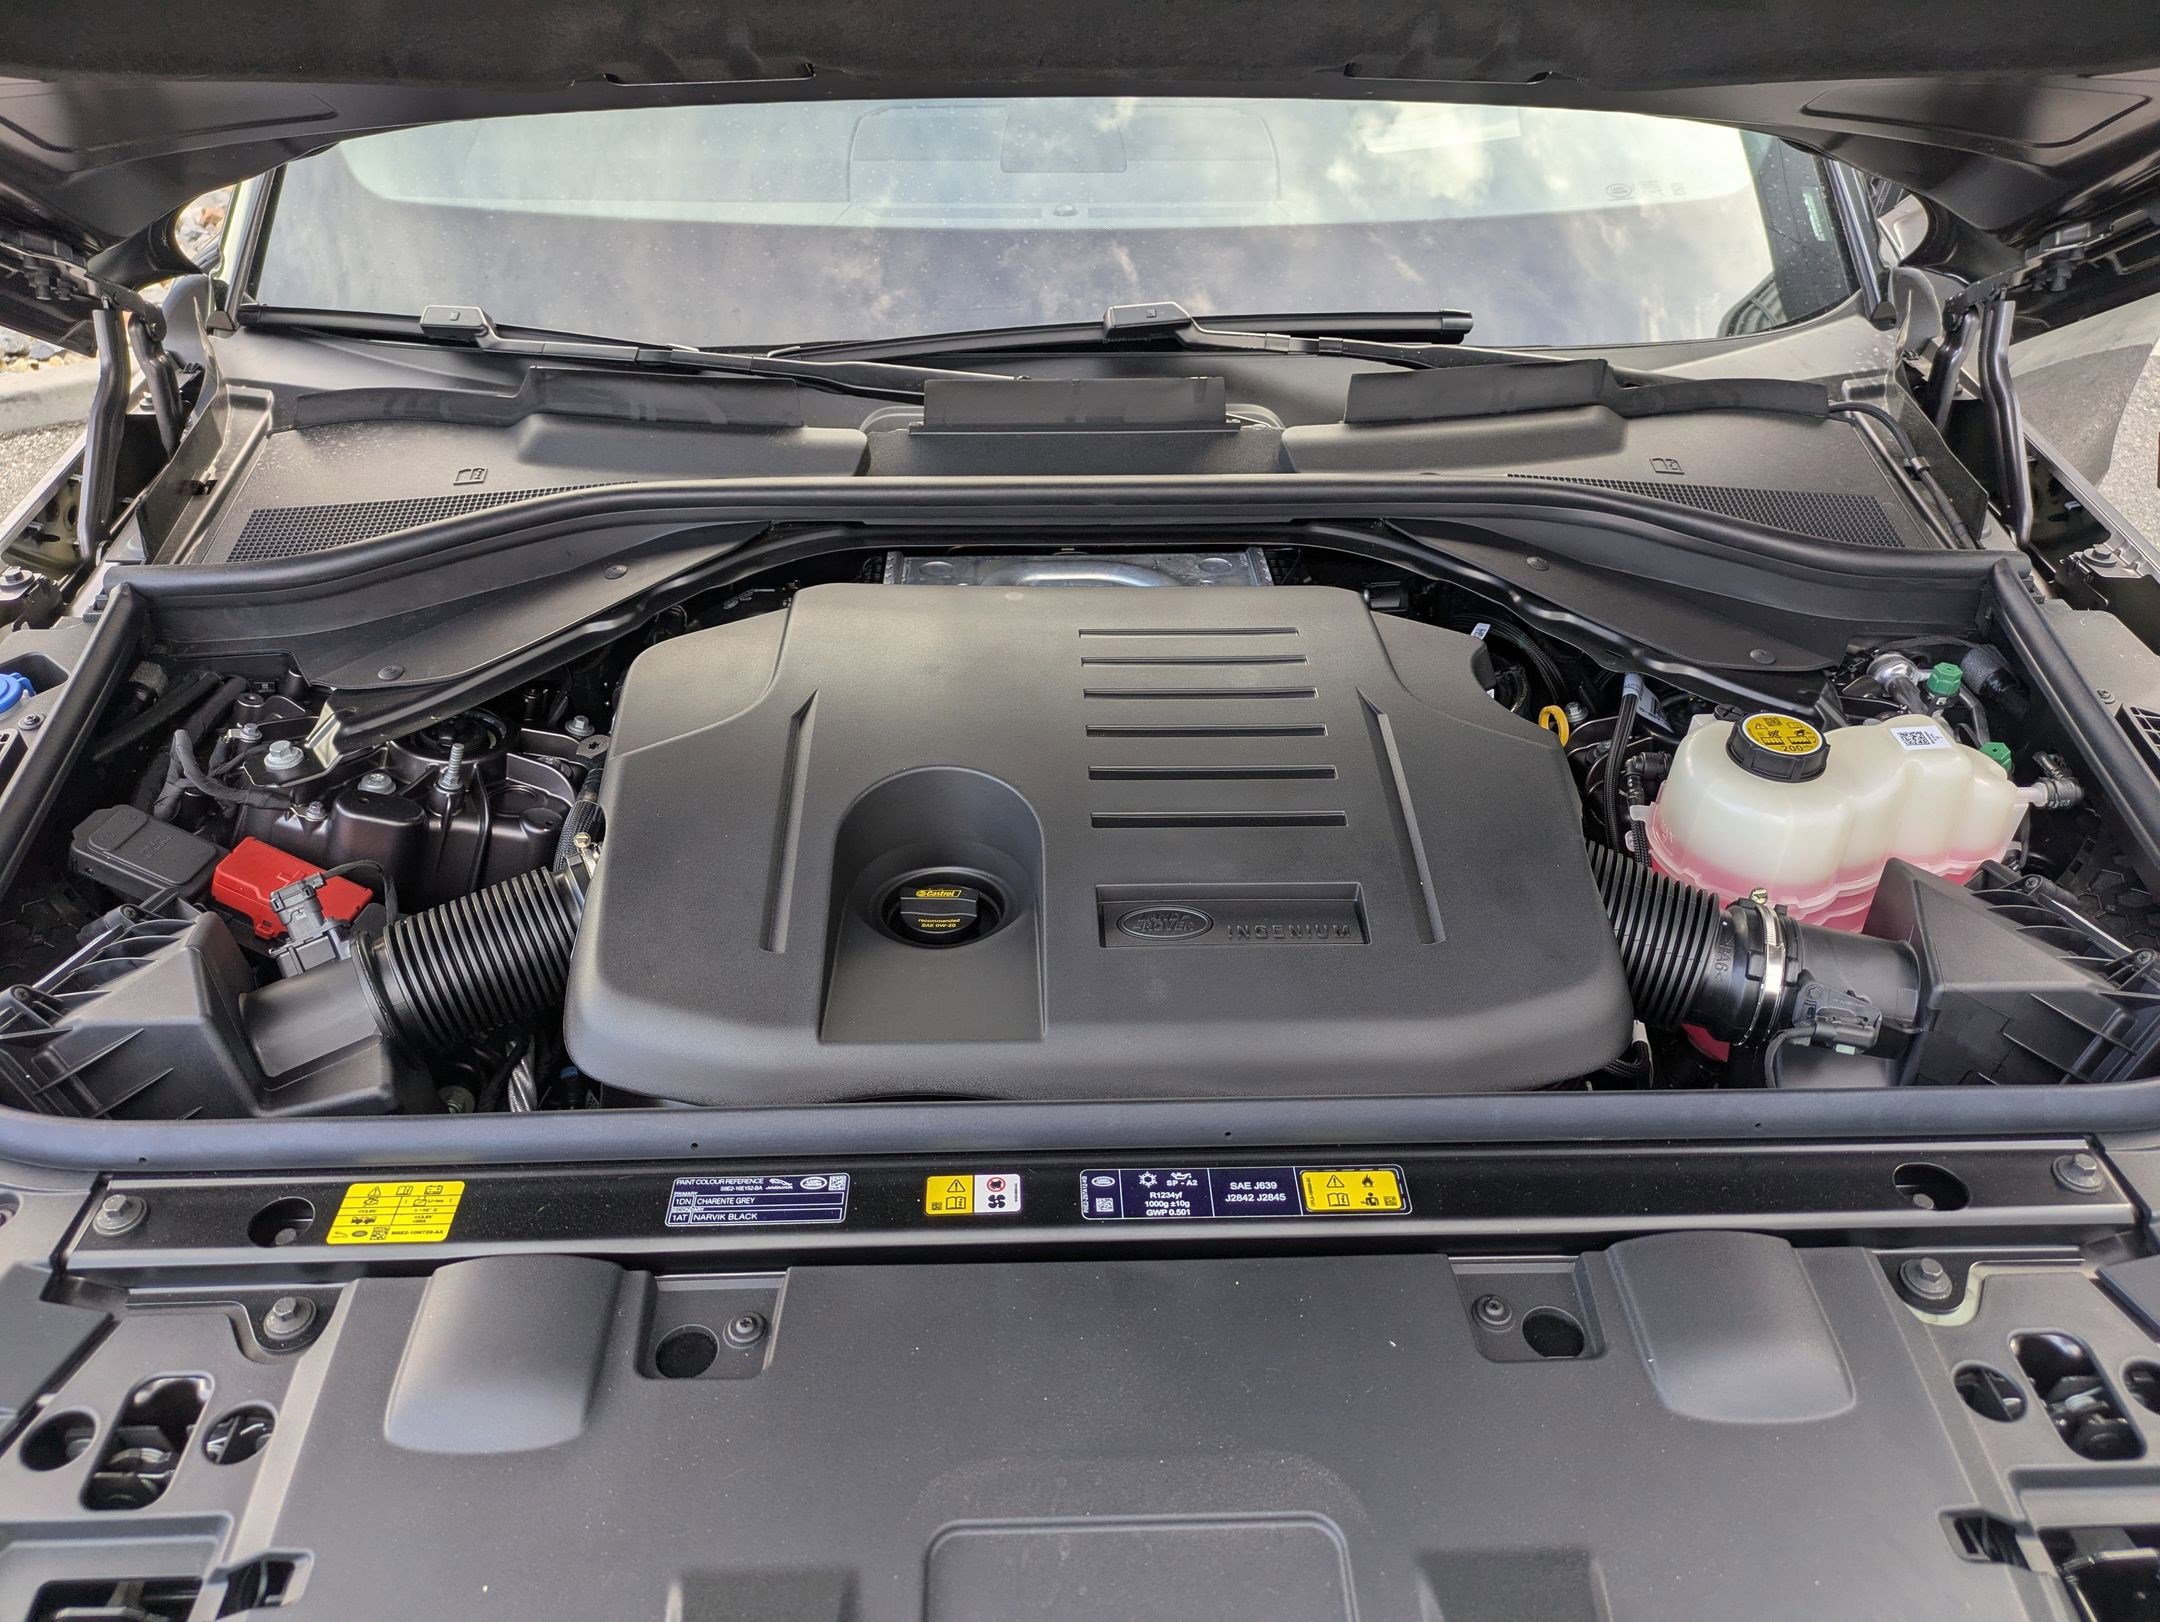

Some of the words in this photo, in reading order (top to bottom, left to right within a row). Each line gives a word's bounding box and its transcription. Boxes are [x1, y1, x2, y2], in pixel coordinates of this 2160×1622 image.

[1142, 920, 1194, 932] ROVER
[1226, 924, 1351, 940] INGENIUM
[1229, 1181, 1252, 1190] SAE
[1253, 1181, 1278, 1190] J639
[1149, 1191, 1183, 1200] R1234yf
[1224, 1193, 1255, 1202] J2842
[1256, 1193, 1287, 1202] J2845
[675, 1198, 692, 1206] 1DN
[696, 1197, 734, 1205] CHARENTE
[735, 1197, 756, 1205] GREY
[1144, 1200, 1169, 1209] 1000g
[672, 1213, 689, 1221] 1AT
[693, 1213, 726, 1221] NARVIK
[727, 1212, 758, 1221] BLACK
[1145, 1208, 1168, 1216] GWP
[1168, 1208, 1191, 1216] 0.501
